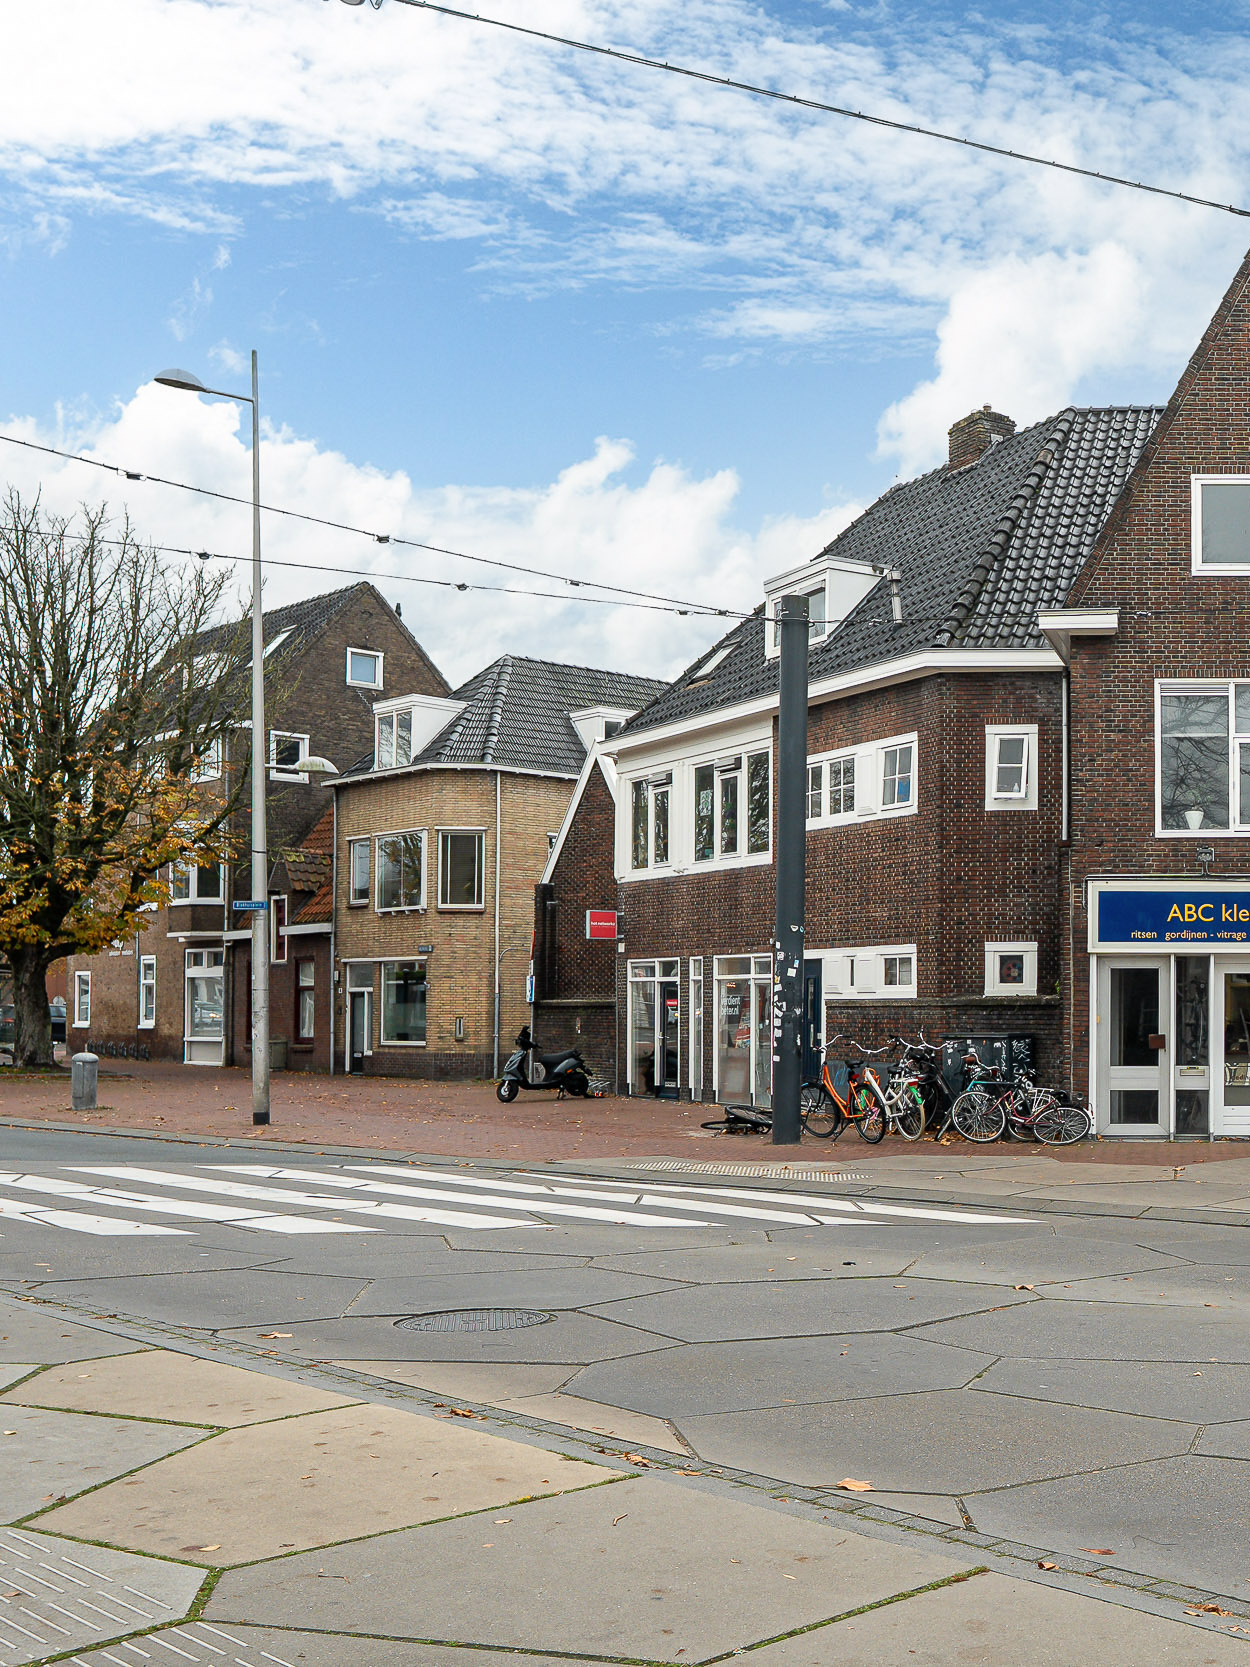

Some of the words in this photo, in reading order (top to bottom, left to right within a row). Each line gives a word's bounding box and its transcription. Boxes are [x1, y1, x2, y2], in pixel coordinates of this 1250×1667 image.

[1167, 903, 1214, 922] ABC
[1131, 930, 1157, 939] ritsen
[1165, 930, 1208, 941] gordijnen
[1217, 930, 1247, 941] vitrage
